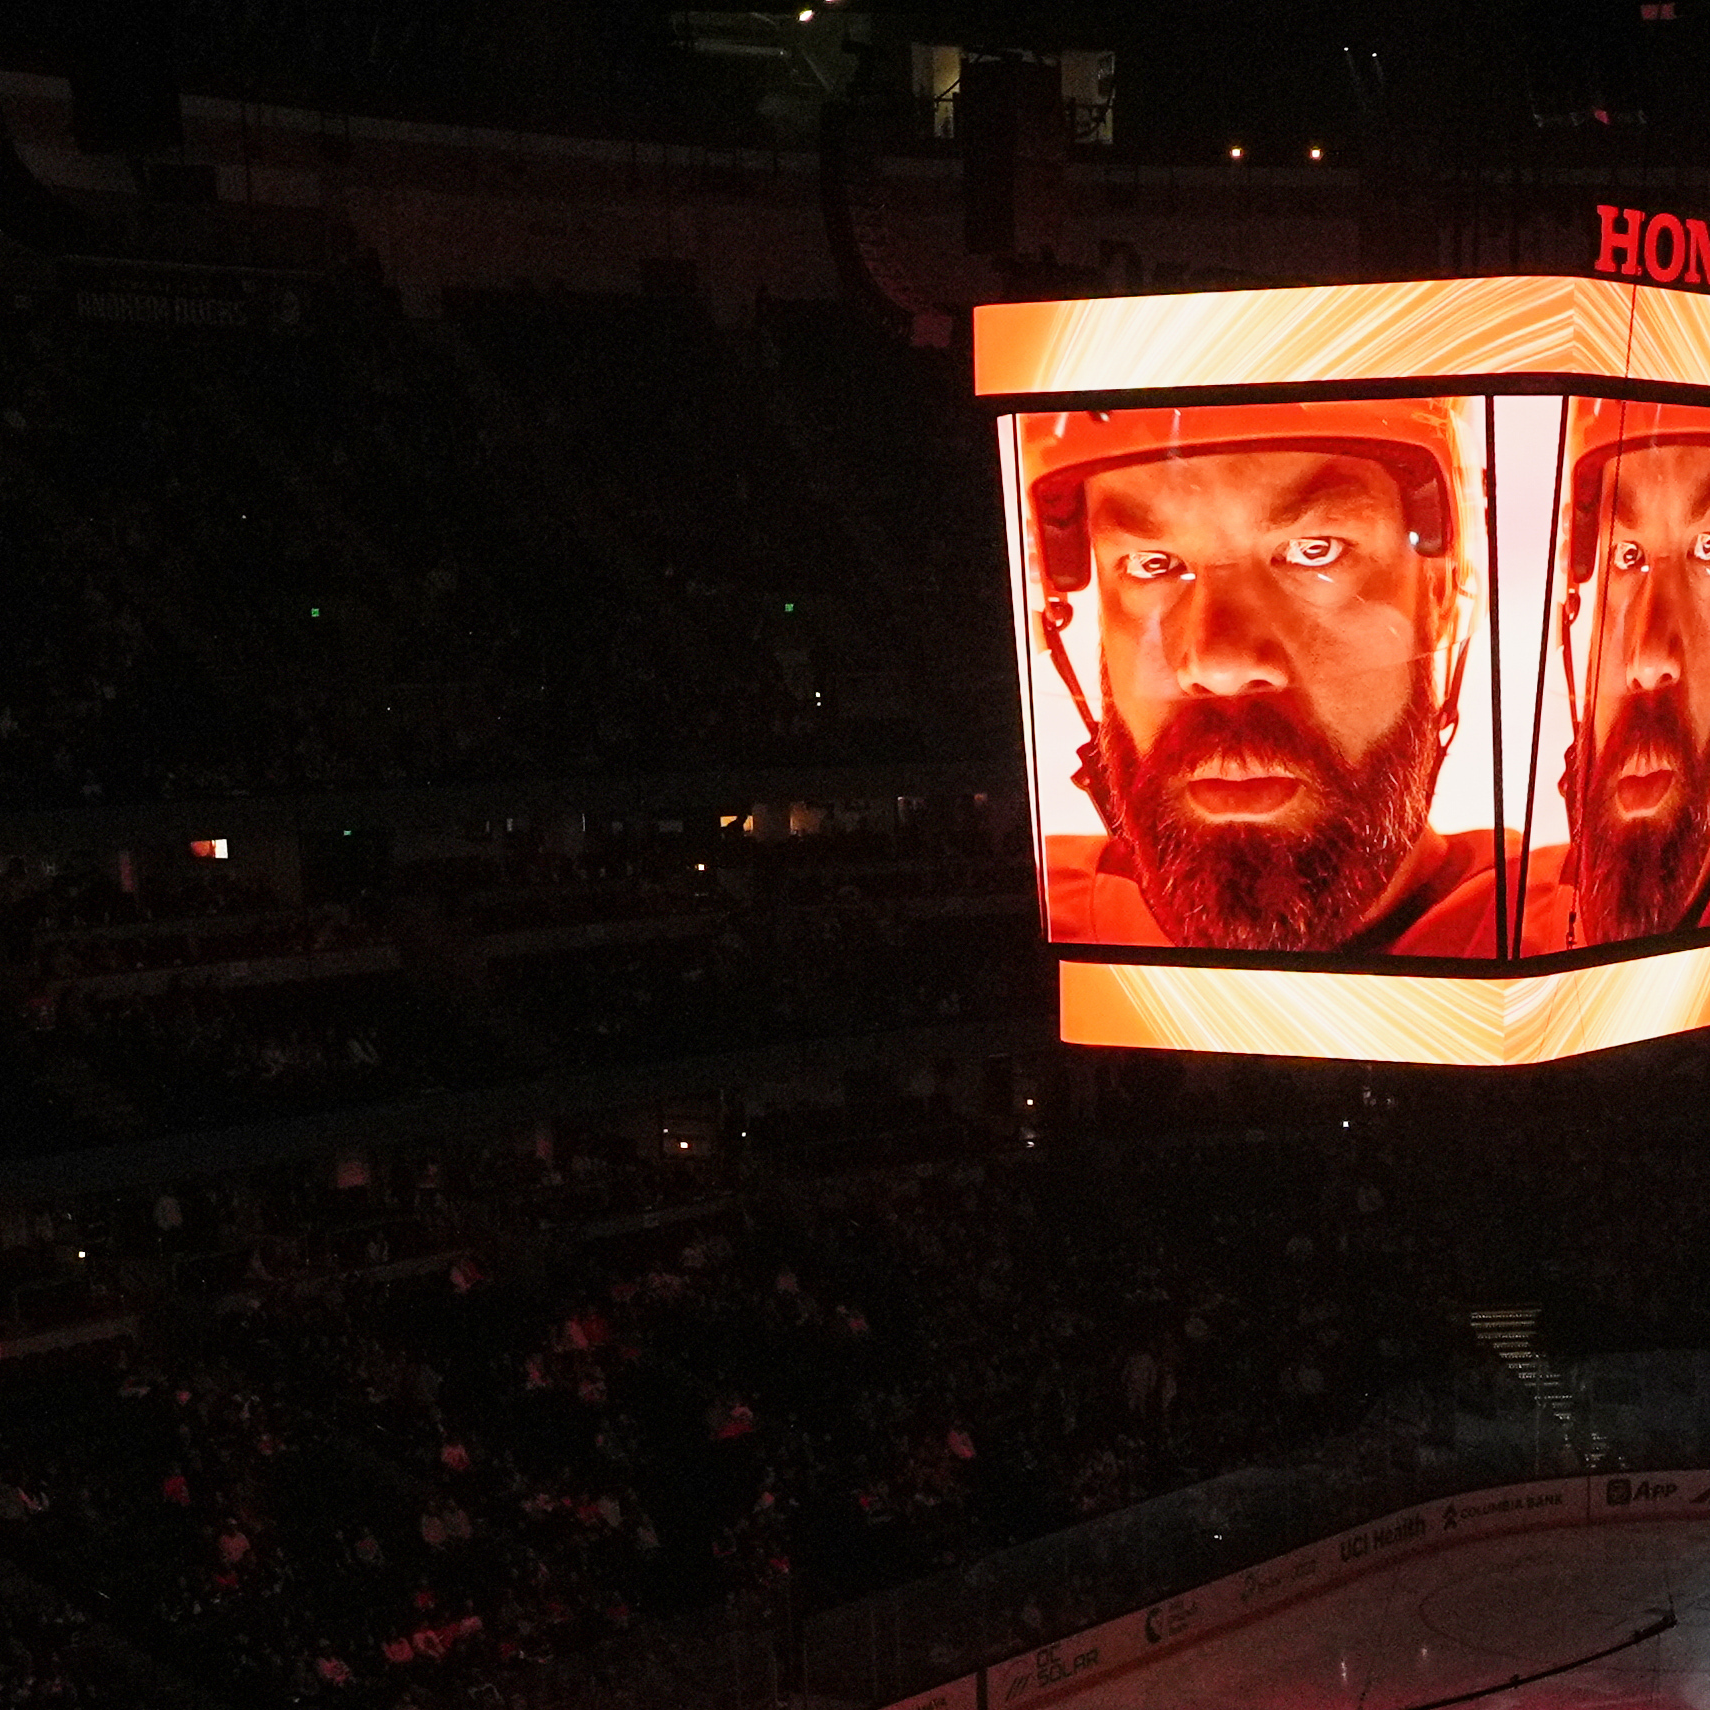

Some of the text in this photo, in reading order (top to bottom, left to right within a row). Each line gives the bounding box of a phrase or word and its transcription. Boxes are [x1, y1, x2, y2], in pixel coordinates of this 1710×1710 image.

[1459, 1493, 1564, 1520] COLUMBIA BANK
[1340, 1512, 1426, 1562] UCI Health
[1036, 1645, 1062, 1668] OC
[1038, 1649, 1100, 1689] SOLAR
